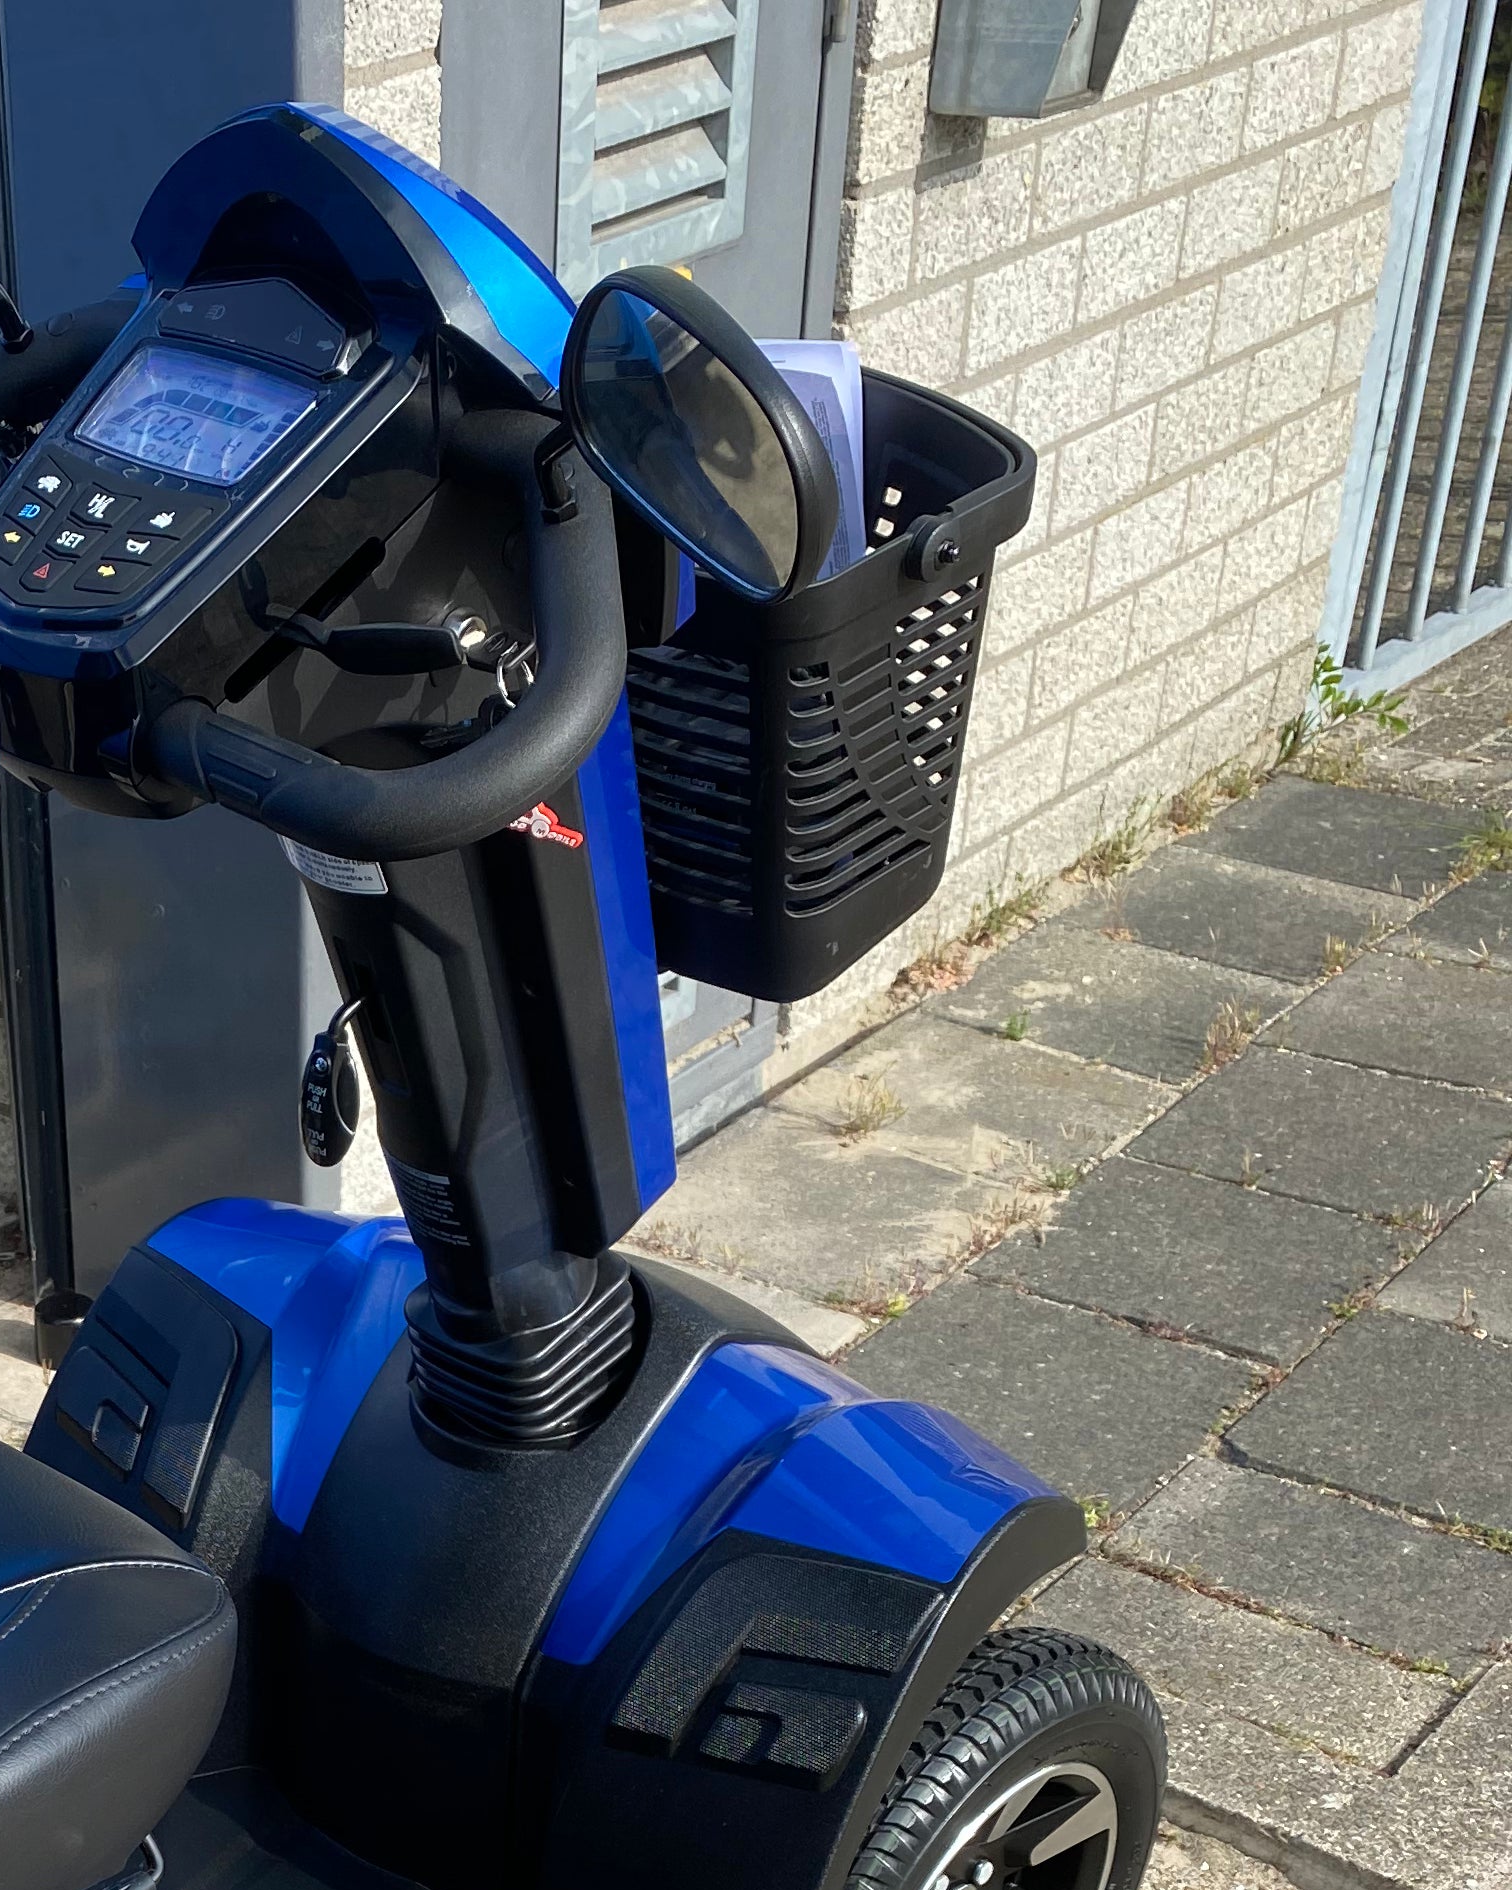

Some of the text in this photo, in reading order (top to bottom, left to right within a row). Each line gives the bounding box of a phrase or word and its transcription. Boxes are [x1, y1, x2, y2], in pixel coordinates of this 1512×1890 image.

[56, 531, 85, 549] SET
[308, 1082, 327, 1097] PUSH
[306, 1100, 323, 1114] PULL
